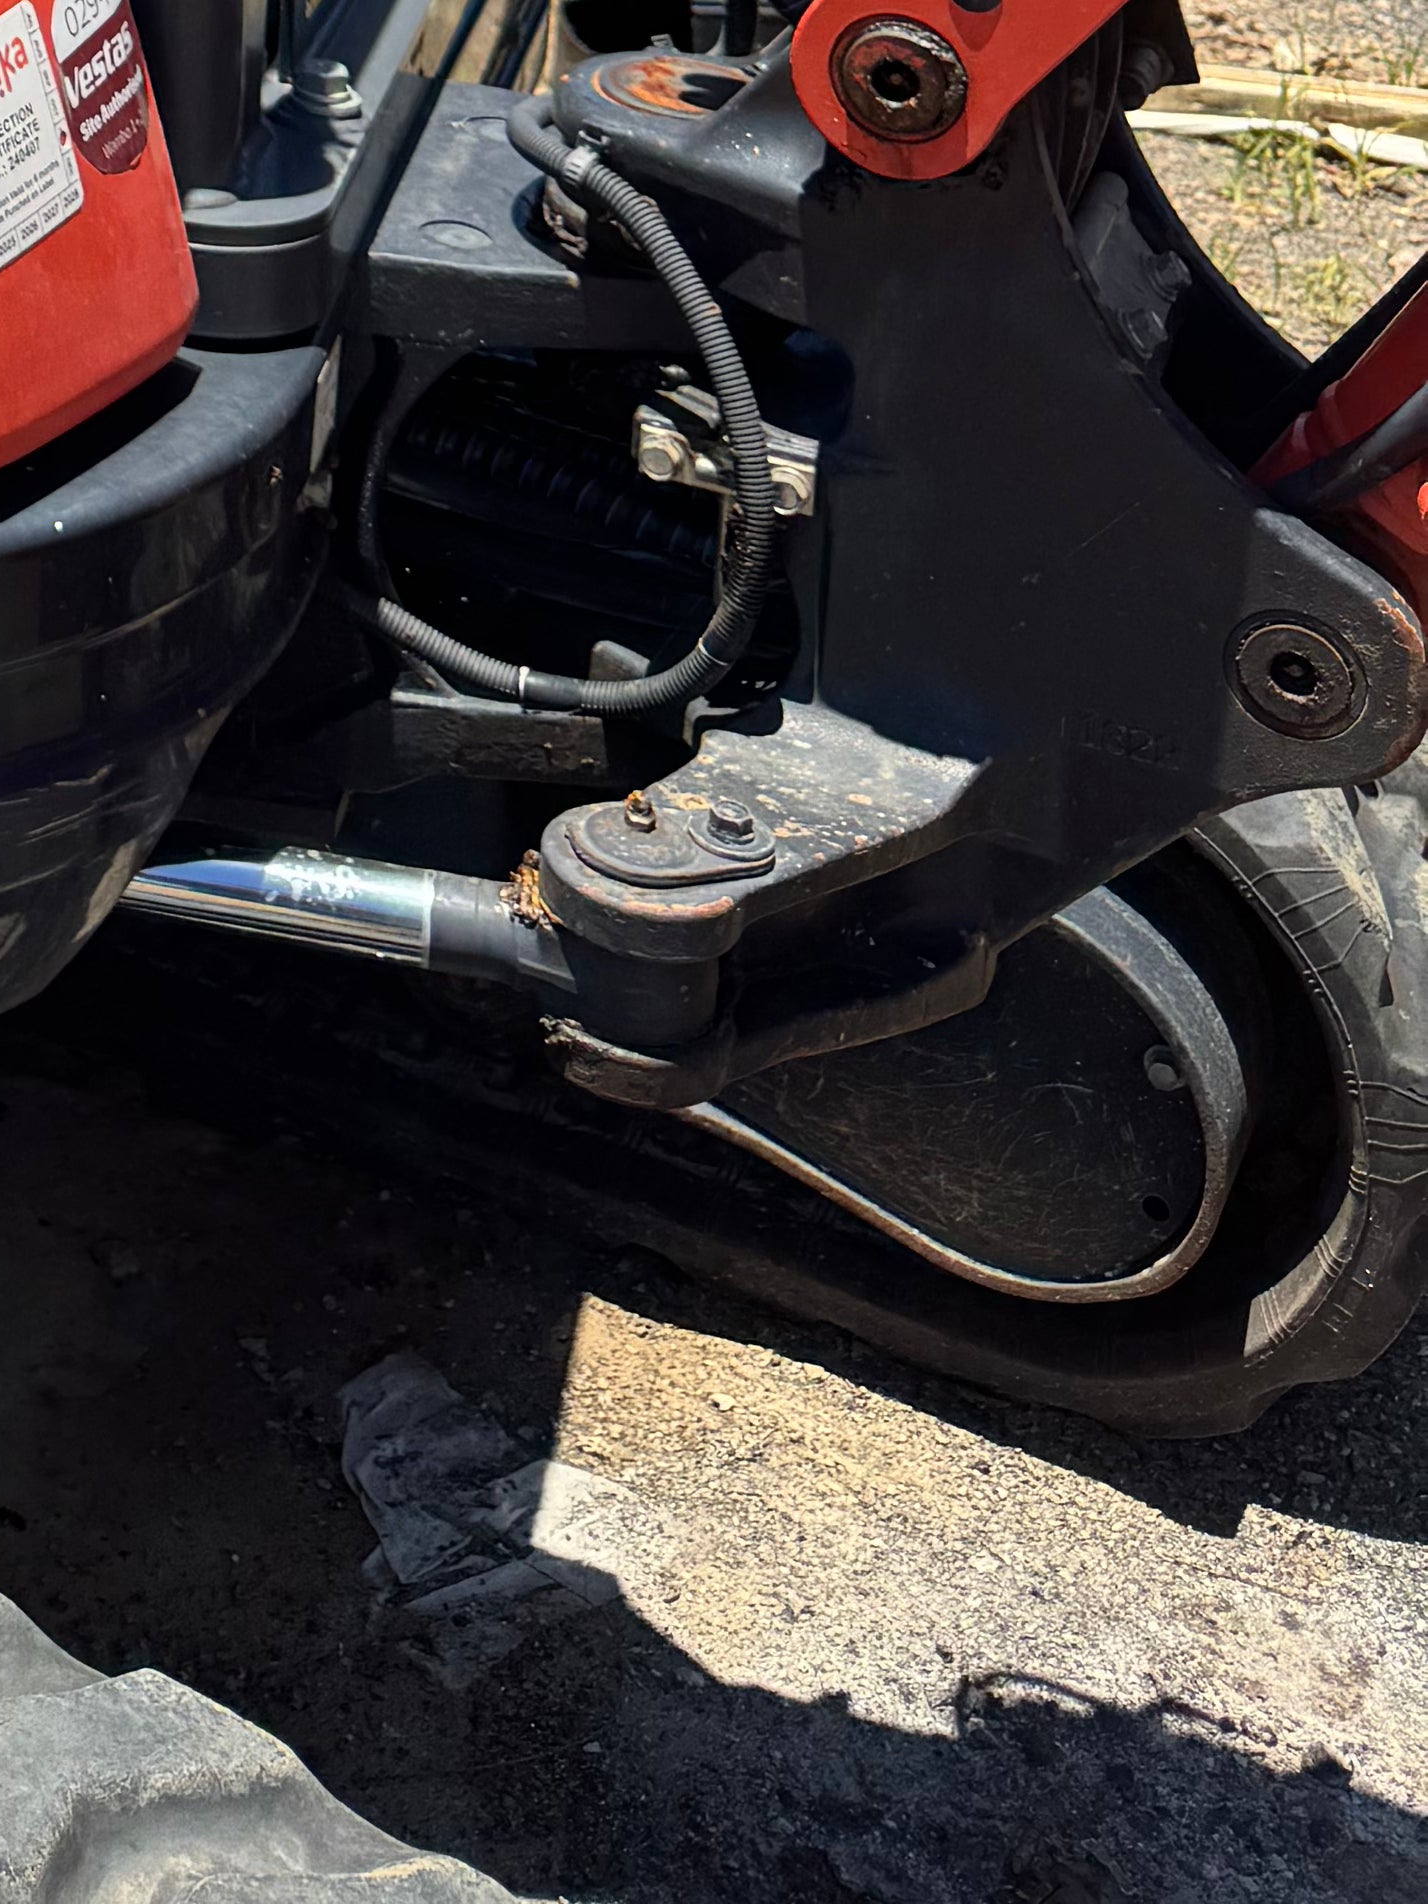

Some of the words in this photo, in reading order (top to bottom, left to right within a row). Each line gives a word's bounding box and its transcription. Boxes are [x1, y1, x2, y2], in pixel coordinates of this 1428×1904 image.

[64, 20, 134, 109] Vestas
[79, 112, 102, 143] Site
[7, 136, 41, 171] 240407
